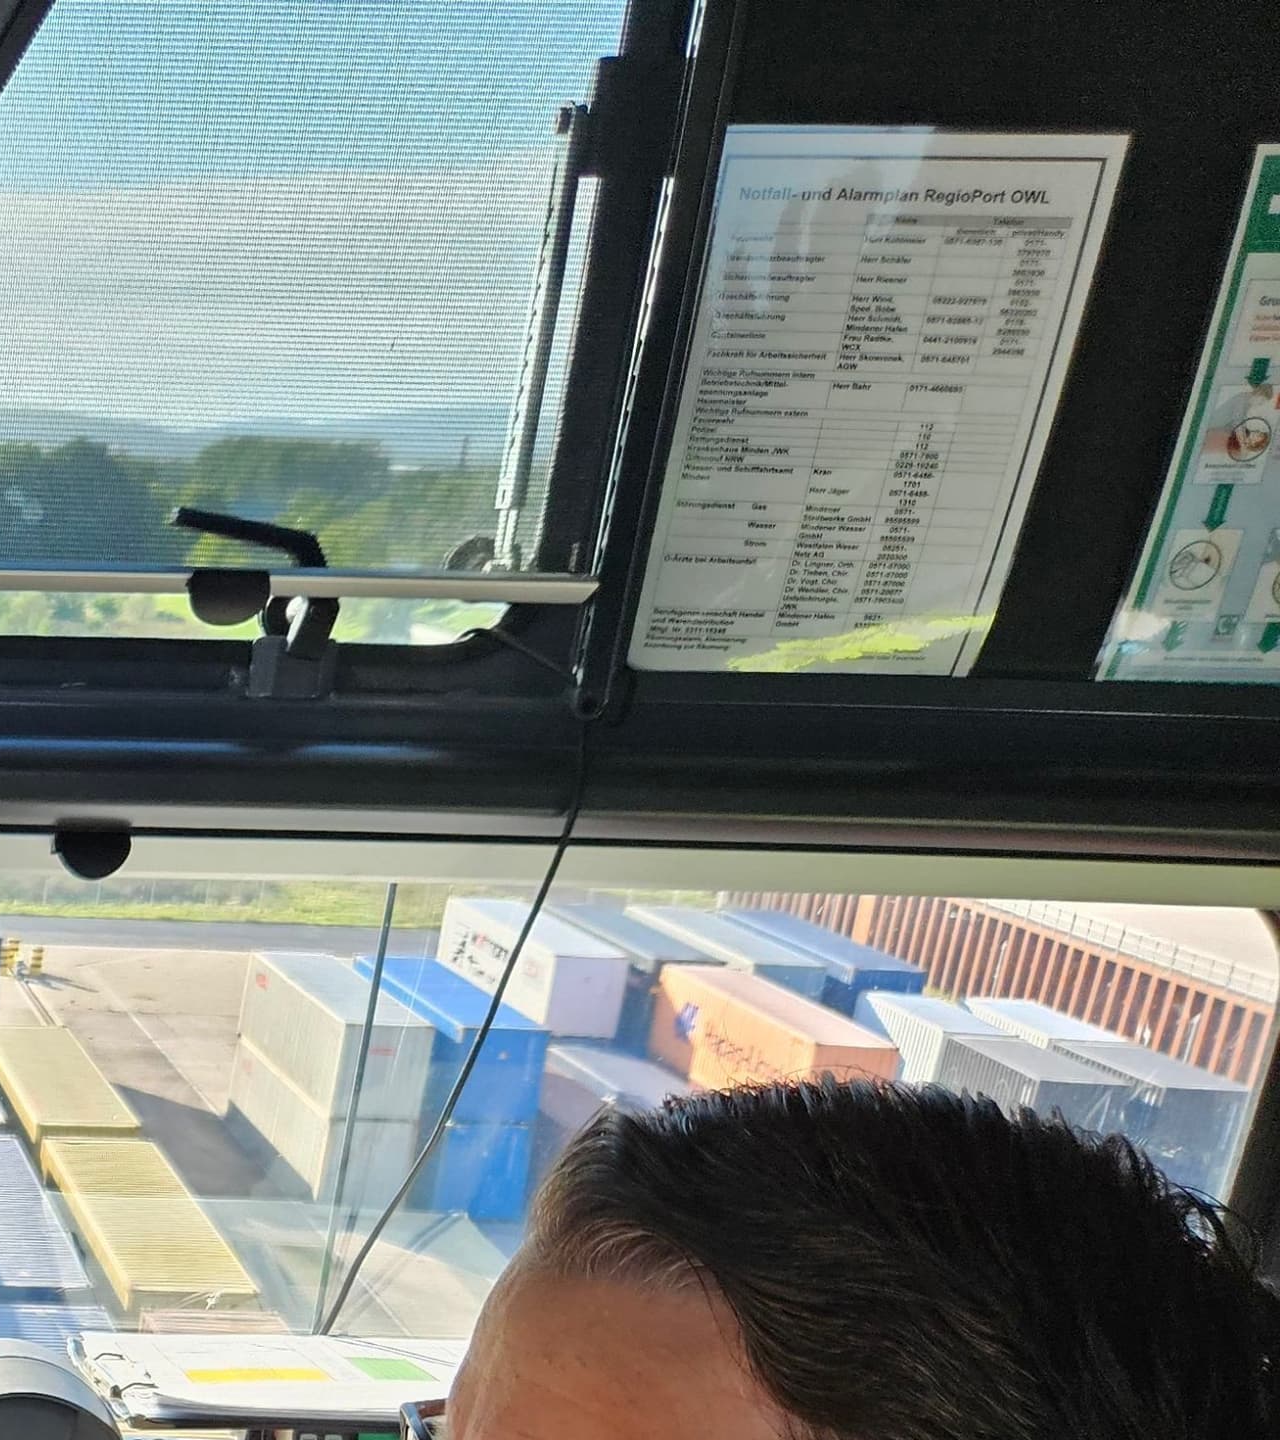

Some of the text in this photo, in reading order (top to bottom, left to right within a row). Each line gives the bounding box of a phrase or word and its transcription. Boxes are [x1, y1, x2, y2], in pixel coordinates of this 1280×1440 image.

[801, 187, 832, 202] und
[836, 187, 919, 205] Alarmplan
[924, 189, 1005, 207] RegioPort
[1011, 190, 1050, 204] OWL
